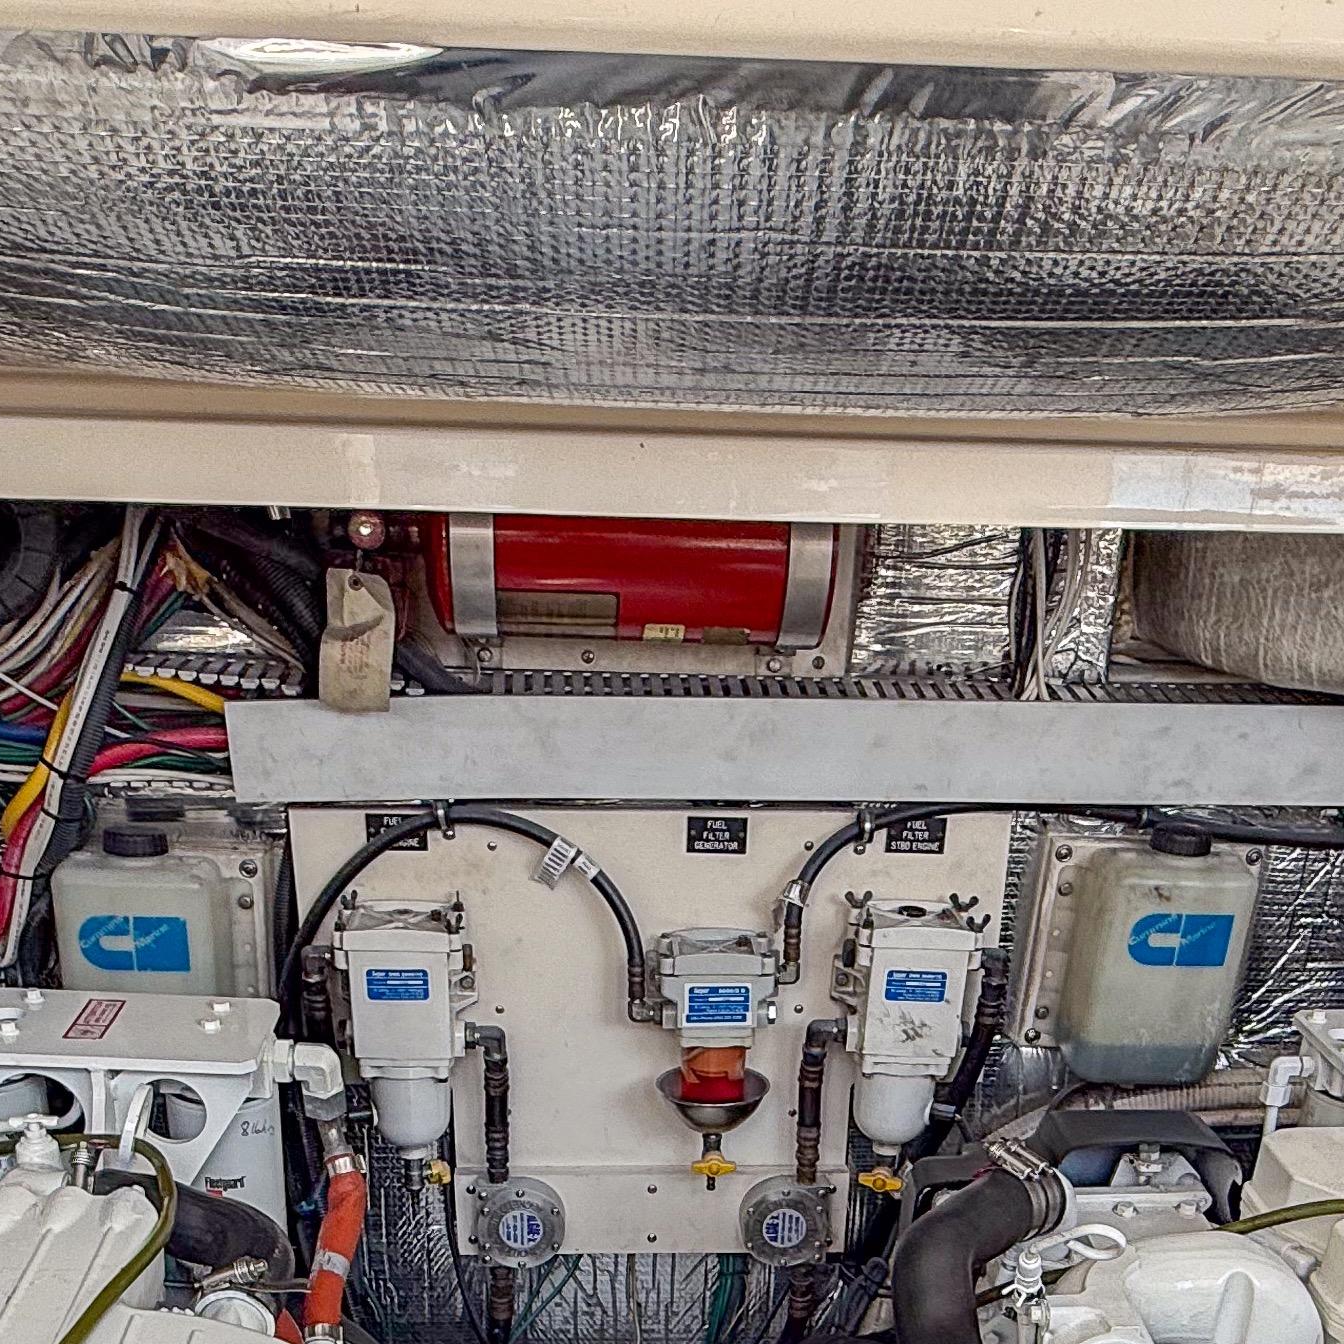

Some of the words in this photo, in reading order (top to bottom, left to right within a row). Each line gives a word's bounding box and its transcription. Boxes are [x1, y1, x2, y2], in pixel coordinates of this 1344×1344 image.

[707, 820, 727, 829] FUEL
[907, 820, 927, 829] FUEL
[702, 831, 730, 840] FILTER
[902, 830, 929, 840] FILTER
